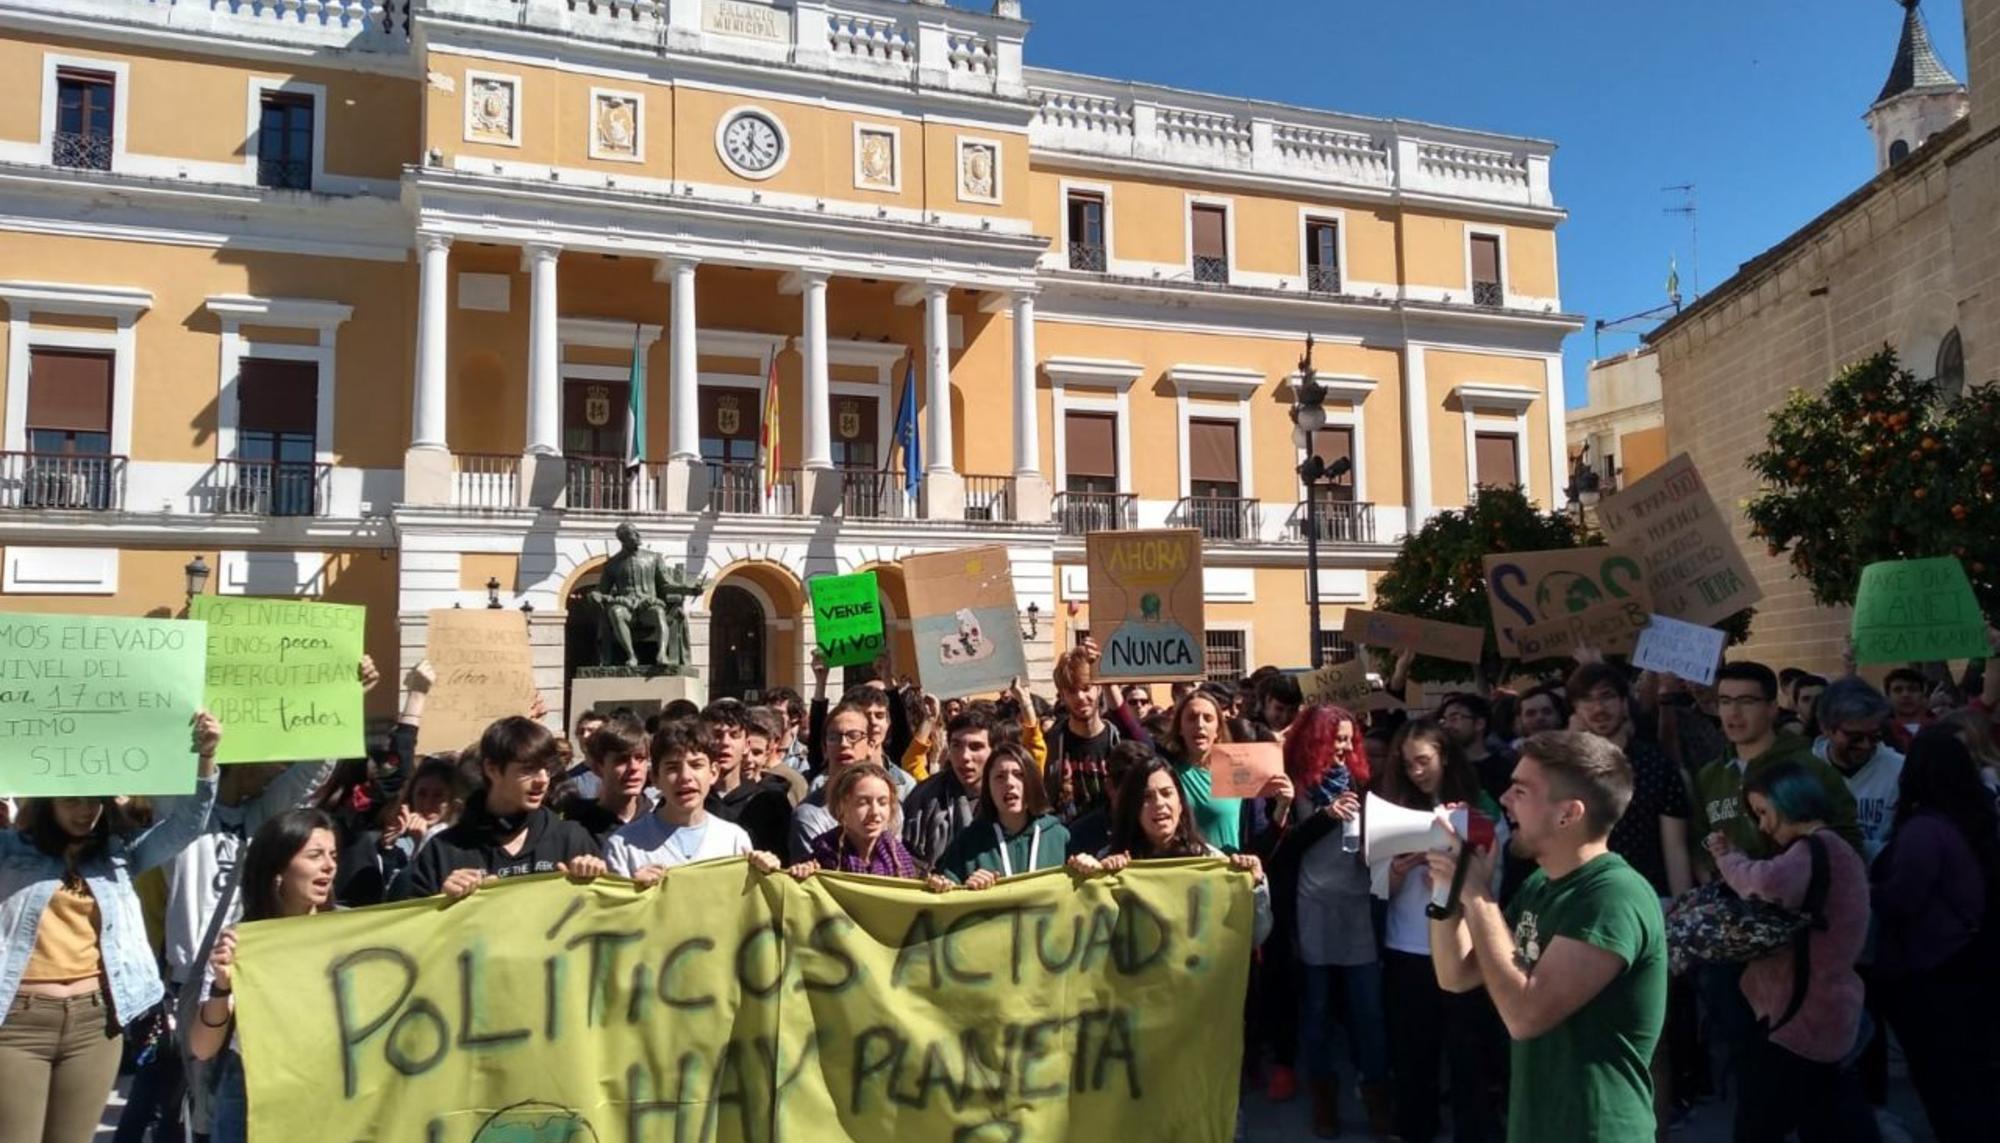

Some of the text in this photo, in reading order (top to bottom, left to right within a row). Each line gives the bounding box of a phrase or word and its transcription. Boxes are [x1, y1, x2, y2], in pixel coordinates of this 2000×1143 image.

[718, 2, 775, 22] PALACIO
[713, 14, 780, 38] MUNICIPAL
[1109, 540, 1187, 572] AHORA
[241, 603, 357, 631] INTERESES
[818, 602, 874, 621] VERDE
[1619, 602, 1649, 627] B
[62, 625, 185, 650] ELEVADO
[225, 635, 271, 655] UNOS
[817, 634, 880, 659] VIVO
[1111, 635, 1194, 667] NUNCA
[84, 659, 128, 679] DEL
[1315, 670, 1342, 689] NO
[47, 683, 87, 709] 17
[95, 691, 128, 708] CM
[138, 691, 172, 709] EN
[209, 697, 269, 724] OBRE
[30, 745, 150, 777] SIGLO
[498, 866, 510, 878] OF
[512, 862, 528, 874] THE
[892, 884, 1208, 991] ACTUAD!
[850, 1008, 1143, 1115] PLANETA
